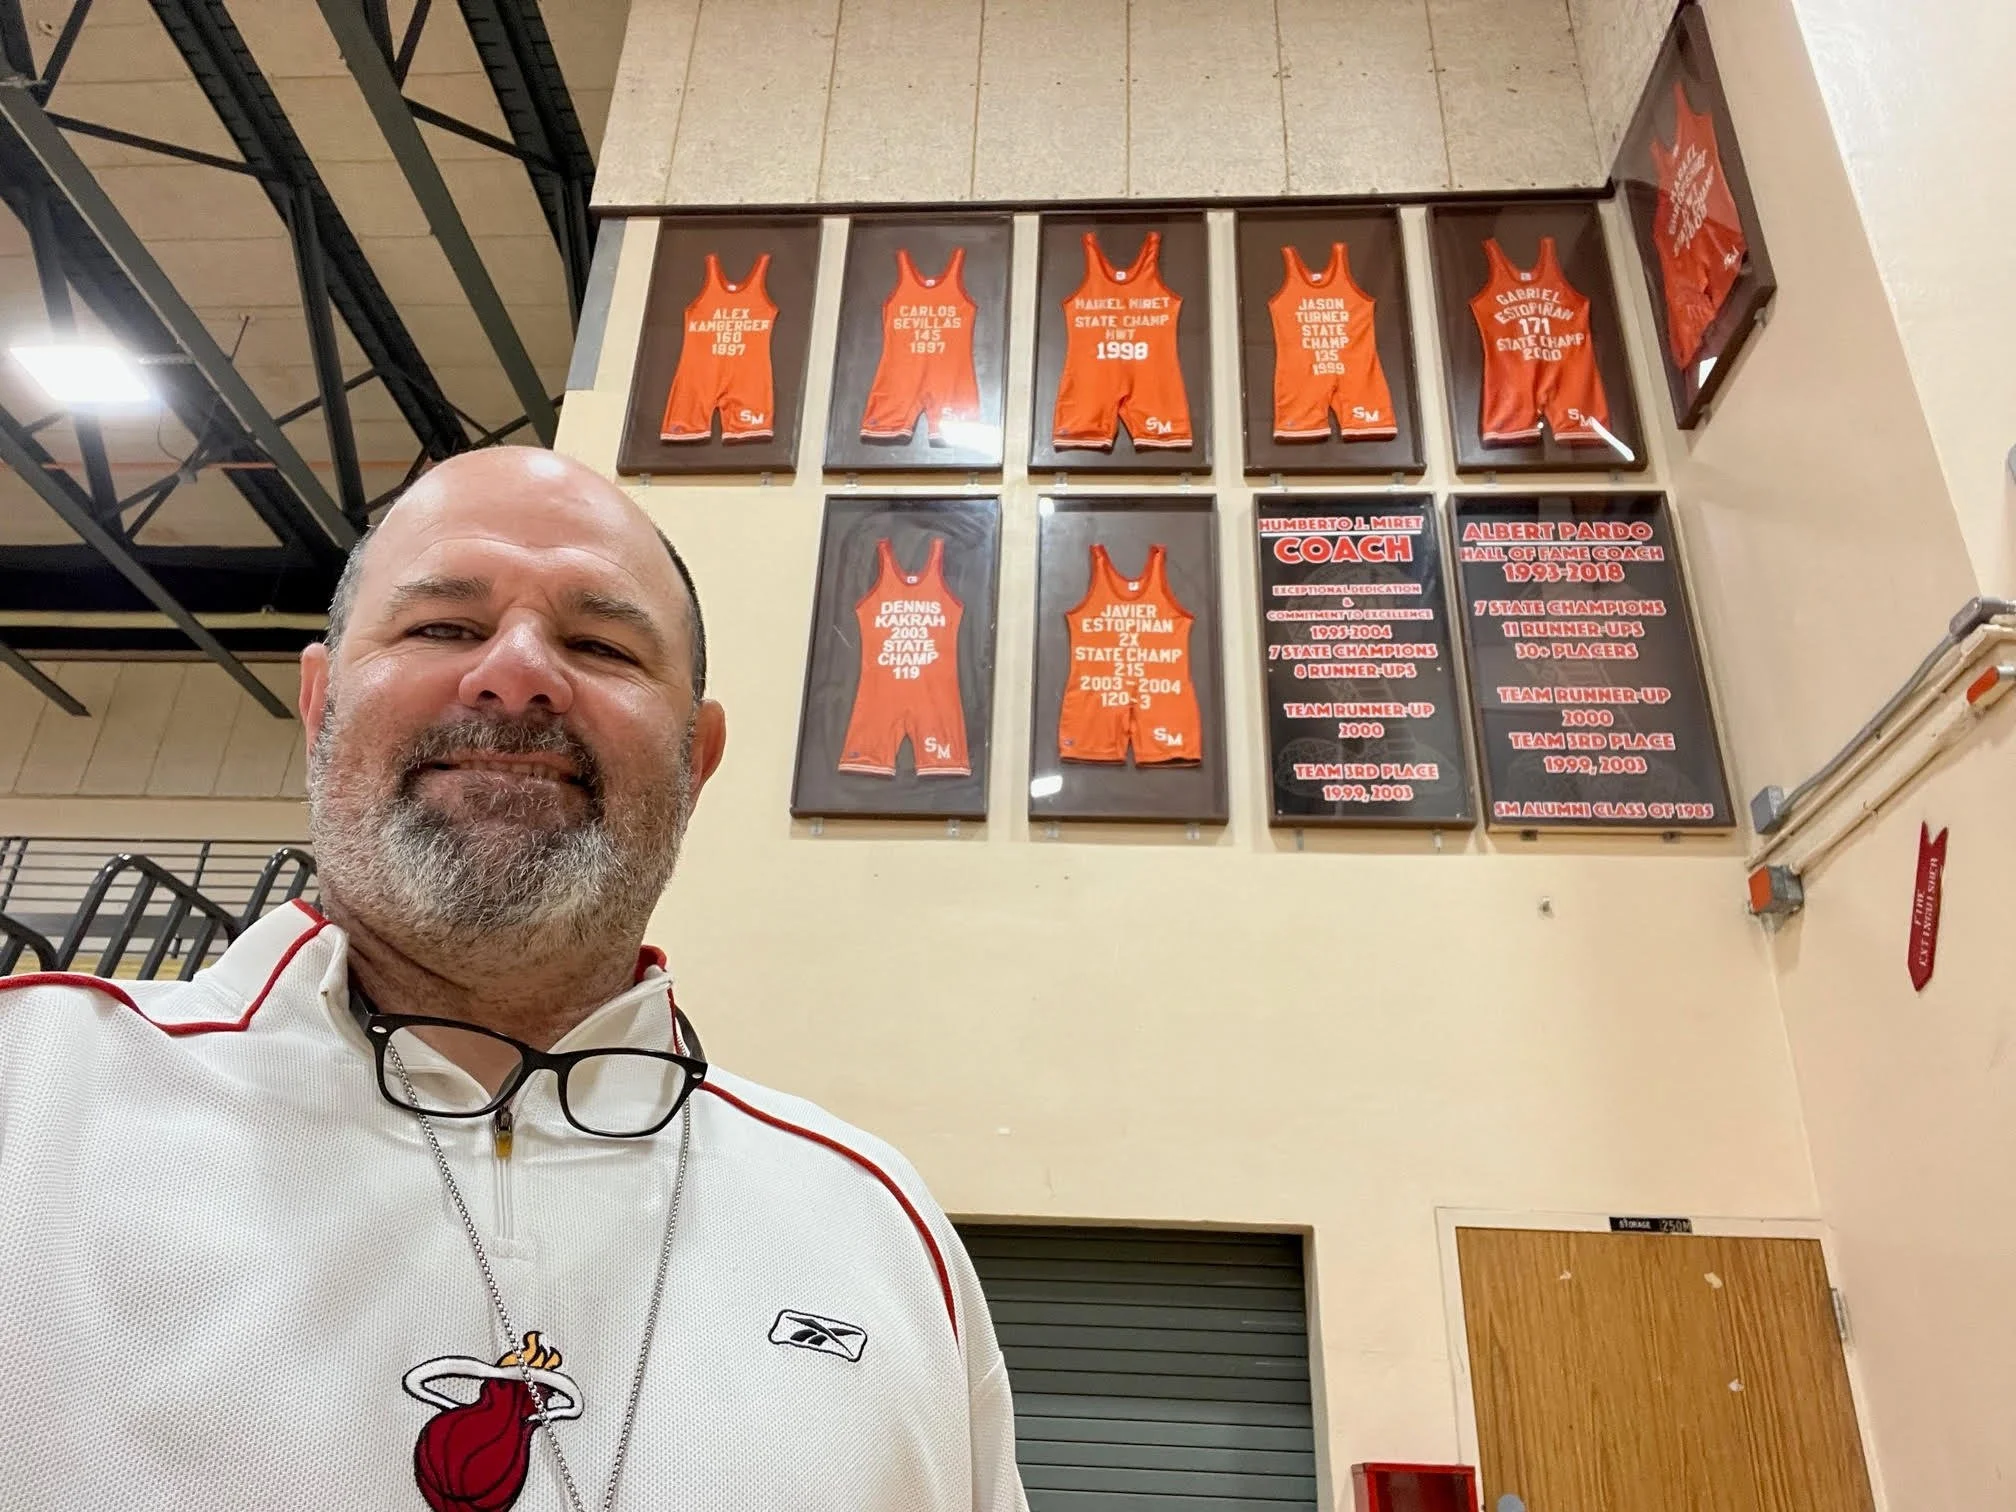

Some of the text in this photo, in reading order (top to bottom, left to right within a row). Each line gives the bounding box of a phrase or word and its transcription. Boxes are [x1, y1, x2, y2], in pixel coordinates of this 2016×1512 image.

[1298, 298, 1345, 310] JASON
[1496, 287, 1560, 305] GABRIEL
[713, 308, 750, 320] ALEX
[900, 305, 957, 318] CARLOS
[1295, 311, 1349, 323] TURNER
[893, 317, 962, 330] SEVILLAS
[1075, 314, 1170, 328] STATE CHAMP
[1519, 317, 1550, 336] 171
[716, 332, 742, 343] 160
[914, 329, 942, 341] 145
[1302, 324, 1346, 336] STATE
[910, 342, 946, 354] 1997
[1302, 336, 1350, 350] CHAMP
[1496, 332, 1585, 352] STATE CHAMP
[1096, 341, 1149, 361] 1998
[1314, 350, 1339, 362] 135
[1522, 347, 1562, 361] 2000
[740, 410, 764, 425] SM
[1352, 406, 1380, 423] SM
[1145, 416, 1173, 435] SM
[1258, 515, 1424, 532] HUMBERTO J. MIRET
[1462, 522, 1653, 541] ALBERT PARDO
[1274, 535, 1414, 564] COACH
[1460, 546, 1664, 562] HALL OF FAME COACH
[1502, 562, 1625, 582] 1993-2018
[1272, 583, 1422, 596] EXCEPTIONAL DEDICATION
[880, 600, 942, 614] DENNIS
[1100, 604, 1157, 618] JAVIER
[1266, 608, 1434, 622] COMMITMENT TO EXCELLENCE
[1474, 600, 1666, 616] 7 STATE CHAMPIONS
[874, 614, 946, 628] KAKRAH
[1081, 618, 1173, 633] ESTOPINAN
[890, 627, 928, 640] 2003
[1310, 624, 1392, 640] 1995-2004
[1502, 622, 1645, 638] 11 RUNNER-UPS
[882, 640, 934, 652] STATE
[1120, 633, 1140, 648] 2X
[877, 651, 940, 666] CHAMP
[1075, 647, 1182, 664] STATE CHAMP
[1268, 643, 1438, 660] 7 STATE CHAMPIONS
[1516, 643, 1638, 659] 30+ PLACERS
[892, 667, 920, 680] 119
[1114, 663, 1144, 677] 215
[1294, 663, 1417, 679] 8 RUNNER-UPS
[1497, 687, 1671, 704] TEAM RUNNER-UP
[1284, 702, 1435, 718] TEAM RUNNER-UP
[1562, 710, 1614, 727] 2000
[1153, 728, 1182, 746] SM
[1338, 722, 1384, 738] 2000
[924, 736, 950, 760] SM
[1508, 732, 1676, 750] TEAM 3RD PLACE
[1294, 763, 1439, 780] TEAM 3RD PLACE
[1543, 756, 1648, 776] 1999, 2003
[1322, 785, 1414, 802] 1999, 2003
[1494, 801, 1714, 818] SM ALUMNI CLASS OF 1985
[1914, 889, 1926, 926] FIRE
